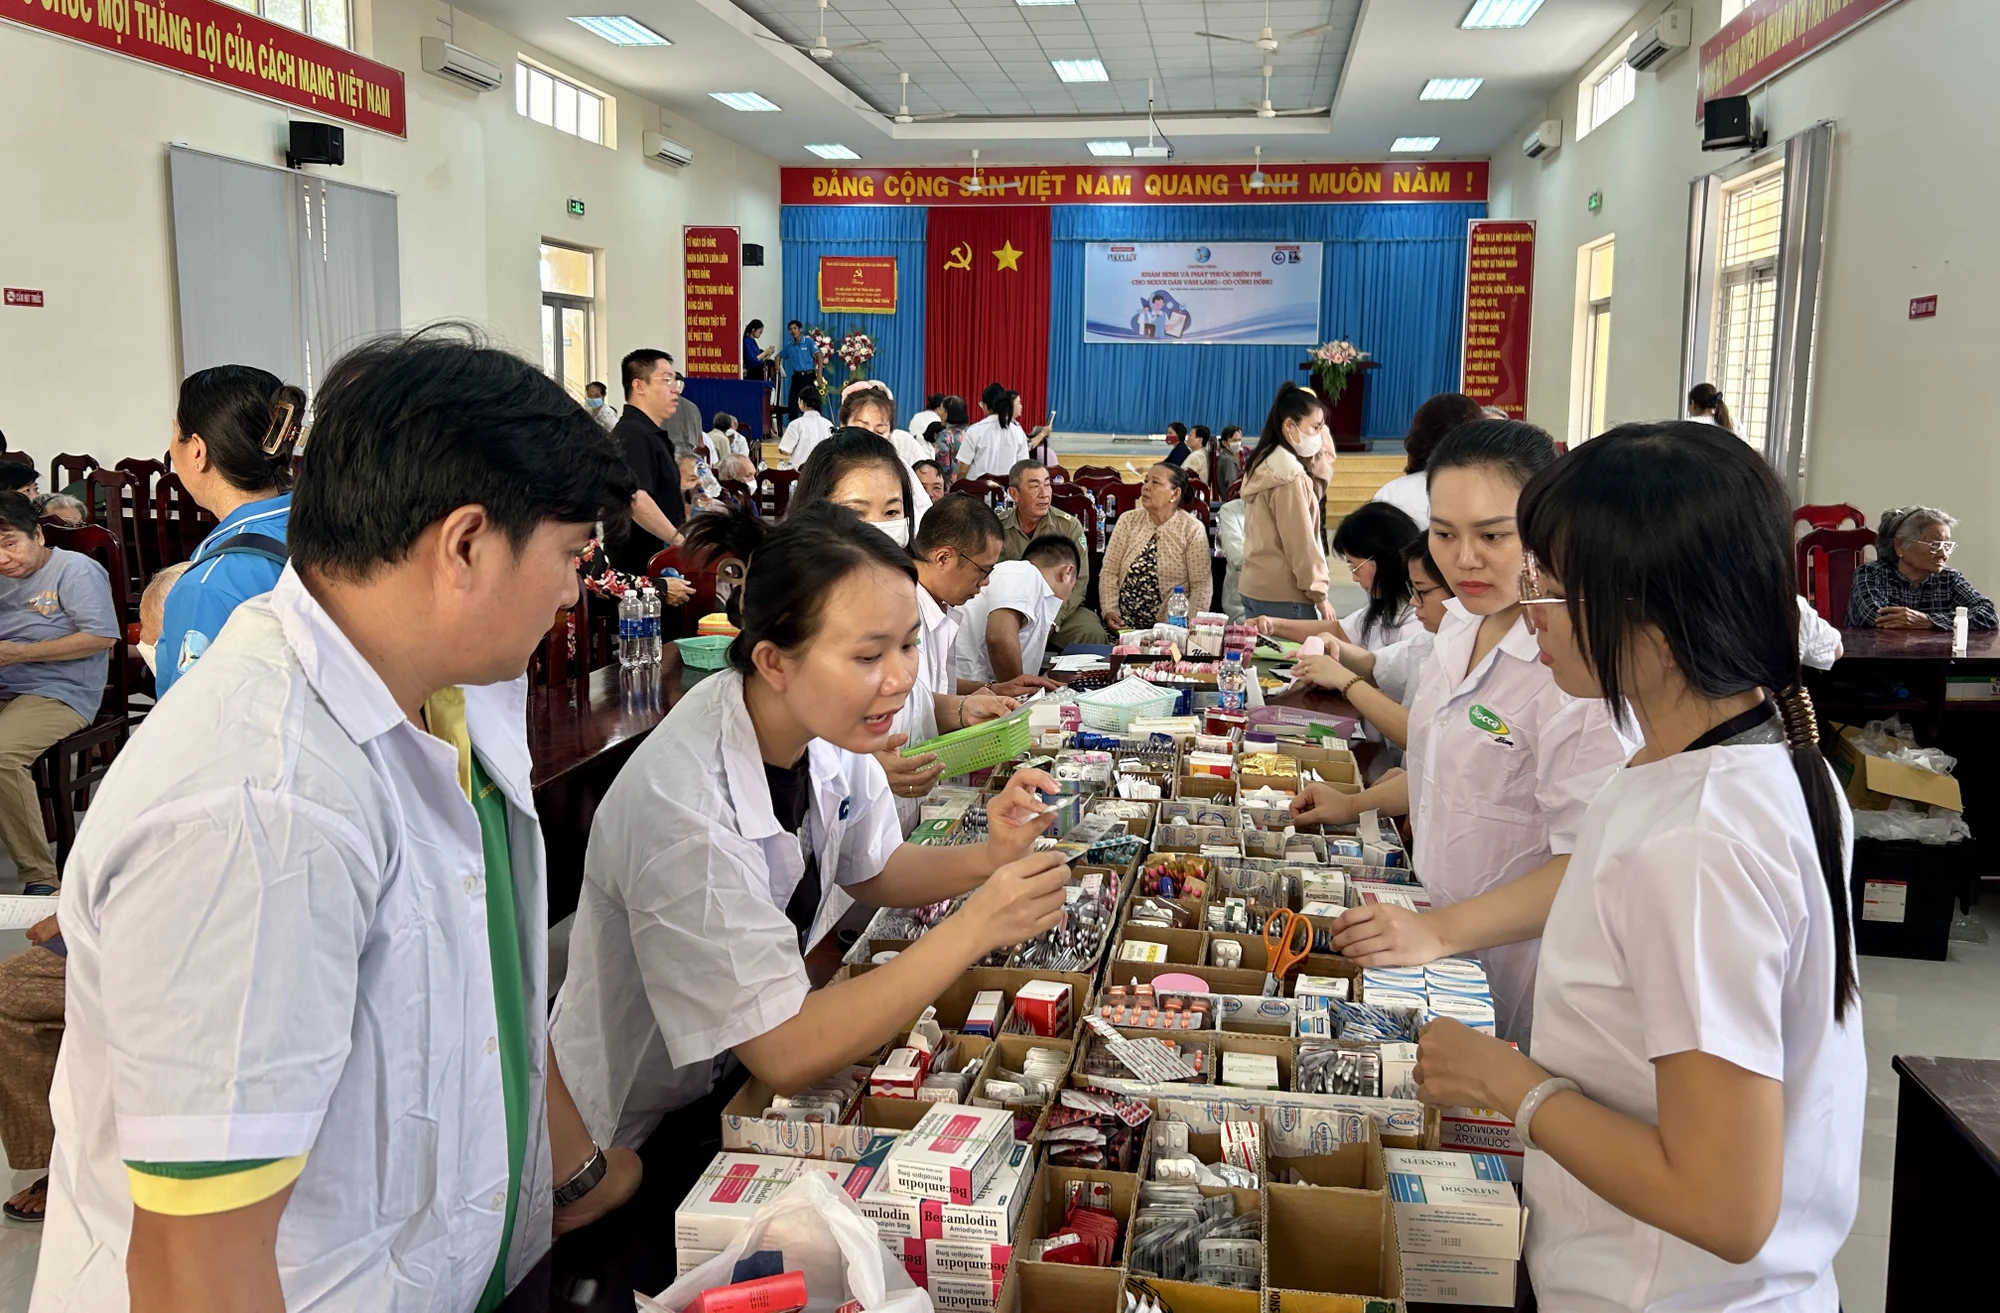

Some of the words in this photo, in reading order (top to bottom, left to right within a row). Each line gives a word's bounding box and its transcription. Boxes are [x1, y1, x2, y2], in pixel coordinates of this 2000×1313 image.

[99, 0, 130, 44] MỌI
[197, 22, 221, 73] LỢI
[225, 22, 255, 75] CỦA
[258, 38, 297, 88] CÁCH
[299, 58, 335, 105] MẠNG
[338, 68, 364, 116] VIỆT
[366, 82, 391, 118] NAM
[813, 169, 874, 197] ĐẢNG
[884, 171, 949, 203] CỘNG
[959, 168, 1006, 197] SẢN
[1015, 170, 1066, 201] VIỆT
[1076, 174, 1132, 196] NAM
[1144, 173, 1229, 197] QUANG
[1309, 167, 1382, 194] MUÔN
[1392, 166, 1451, 193] NĂM
[1466, 171, 1473, 192] !
[1454, 1134, 1511, 1149] ARXIMUOC
[1400, 1158, 1457, 1167] DOGNEFIN
[754, 1167, 784, 1204] Becmlodin
[898, 1178, 968, 1198] Becamlodin
[1441, 1185, 1500, 1196] DOGNEFIN
[861, 1207, 910, 1220] amlodin
[924, 1210, 998, 1227] Becamlodin
[950, 1226, 983, 1234] Amlodipin
[984, 1228, 998, 1236] 5mg
[937, 1258, 1008, 1274] Becamlodin
[938, 1296, 996, 1308] camlodin
